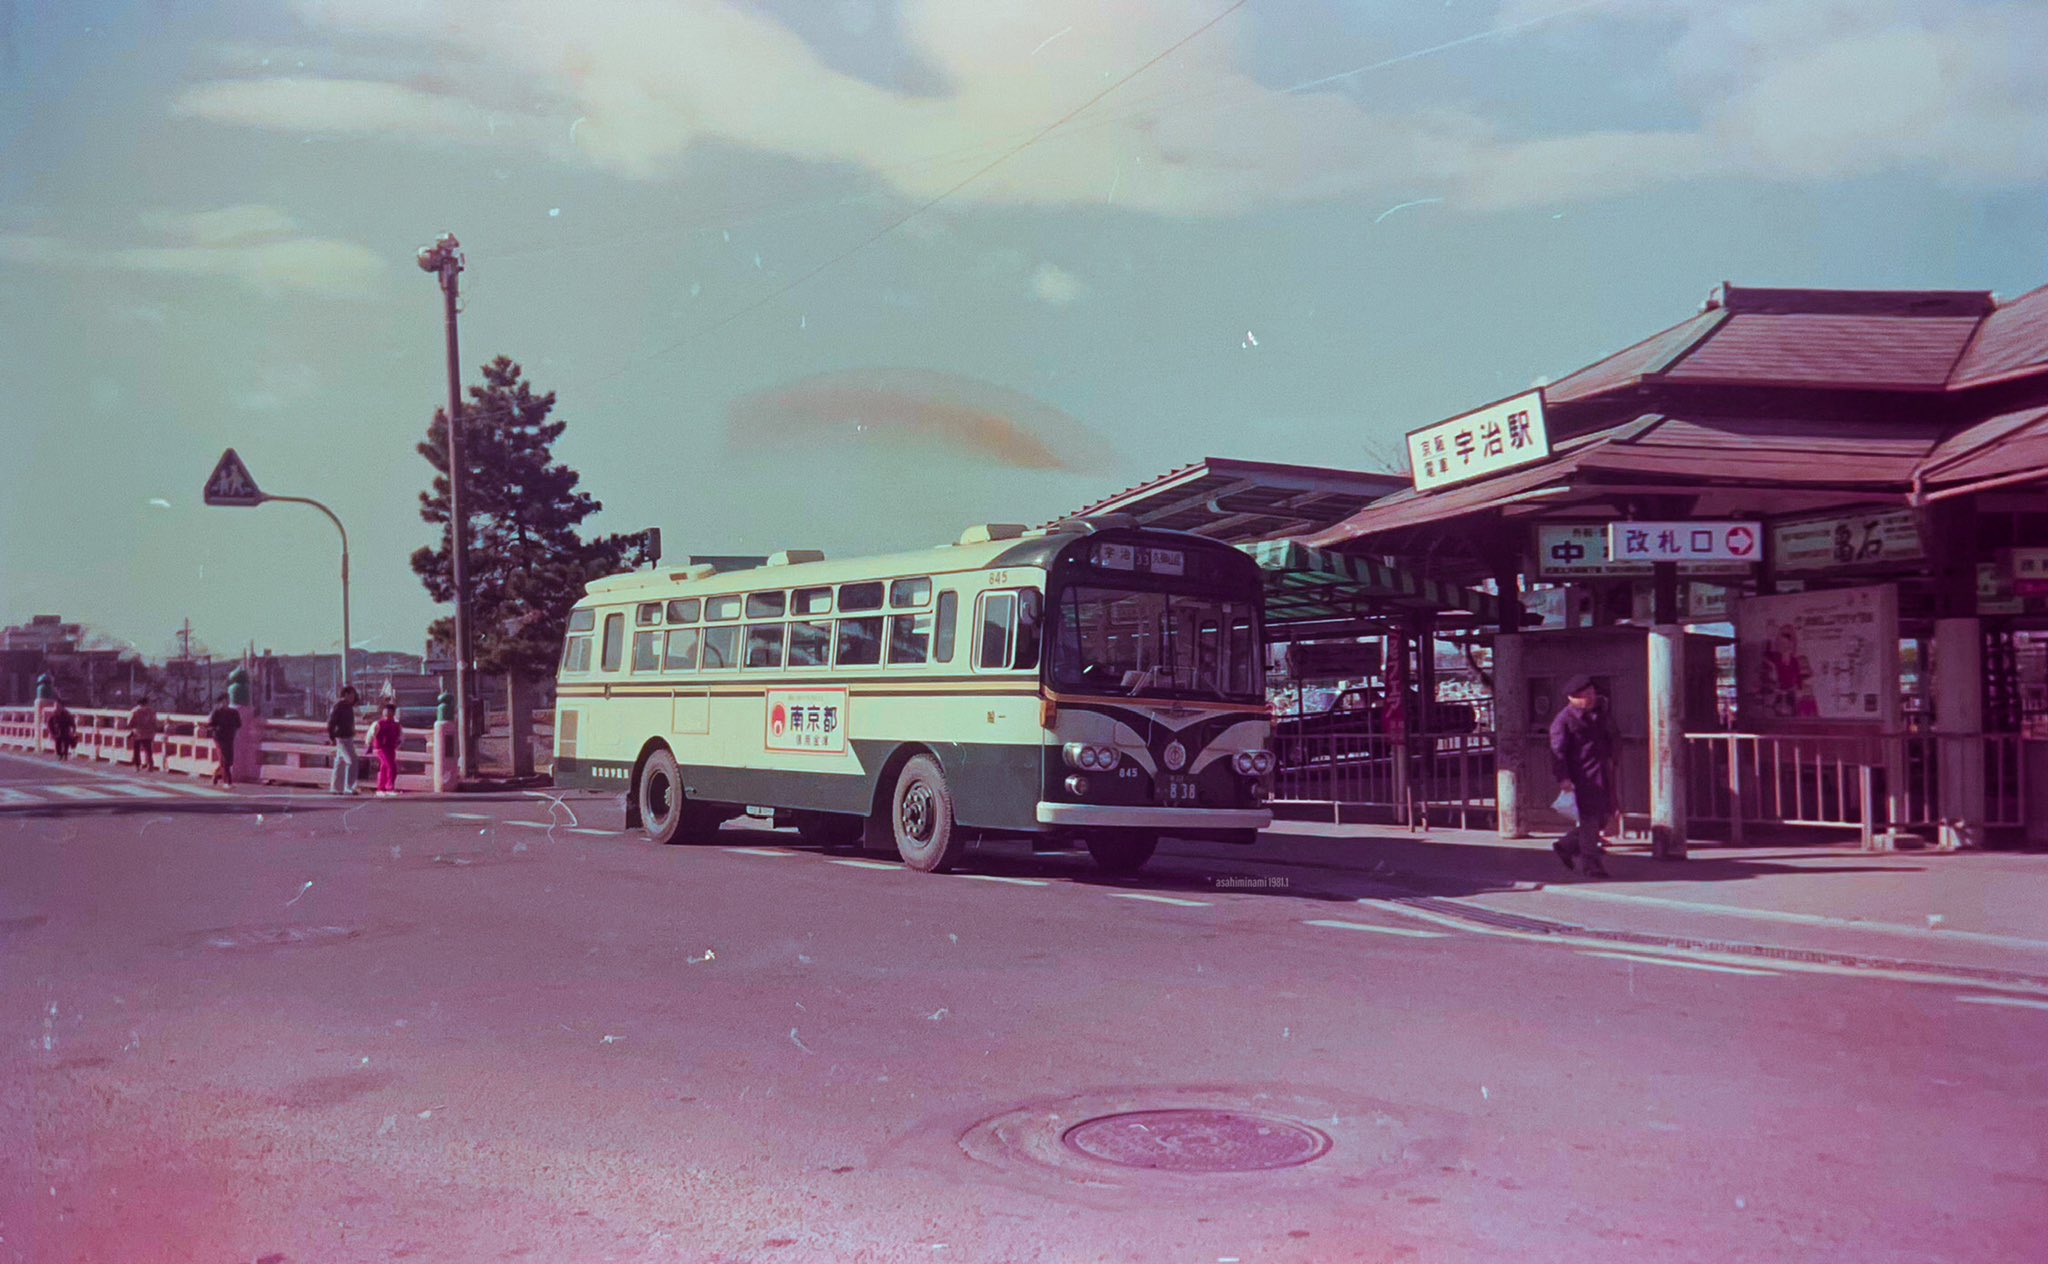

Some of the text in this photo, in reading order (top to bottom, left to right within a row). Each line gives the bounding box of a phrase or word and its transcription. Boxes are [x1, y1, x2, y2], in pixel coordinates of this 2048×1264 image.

[1421, 434, 1445, 457] 京阪
[1454, 410, 1533, 465] 宇治駅
[1626, 529, 1713, 553] 改札口
[1104, 546, 1131, 561] 宇治
[989, 571, 1008, 585] 845
[790, 704, 838, 732] 南京都
[1119, 767, 1138, 778] 845
